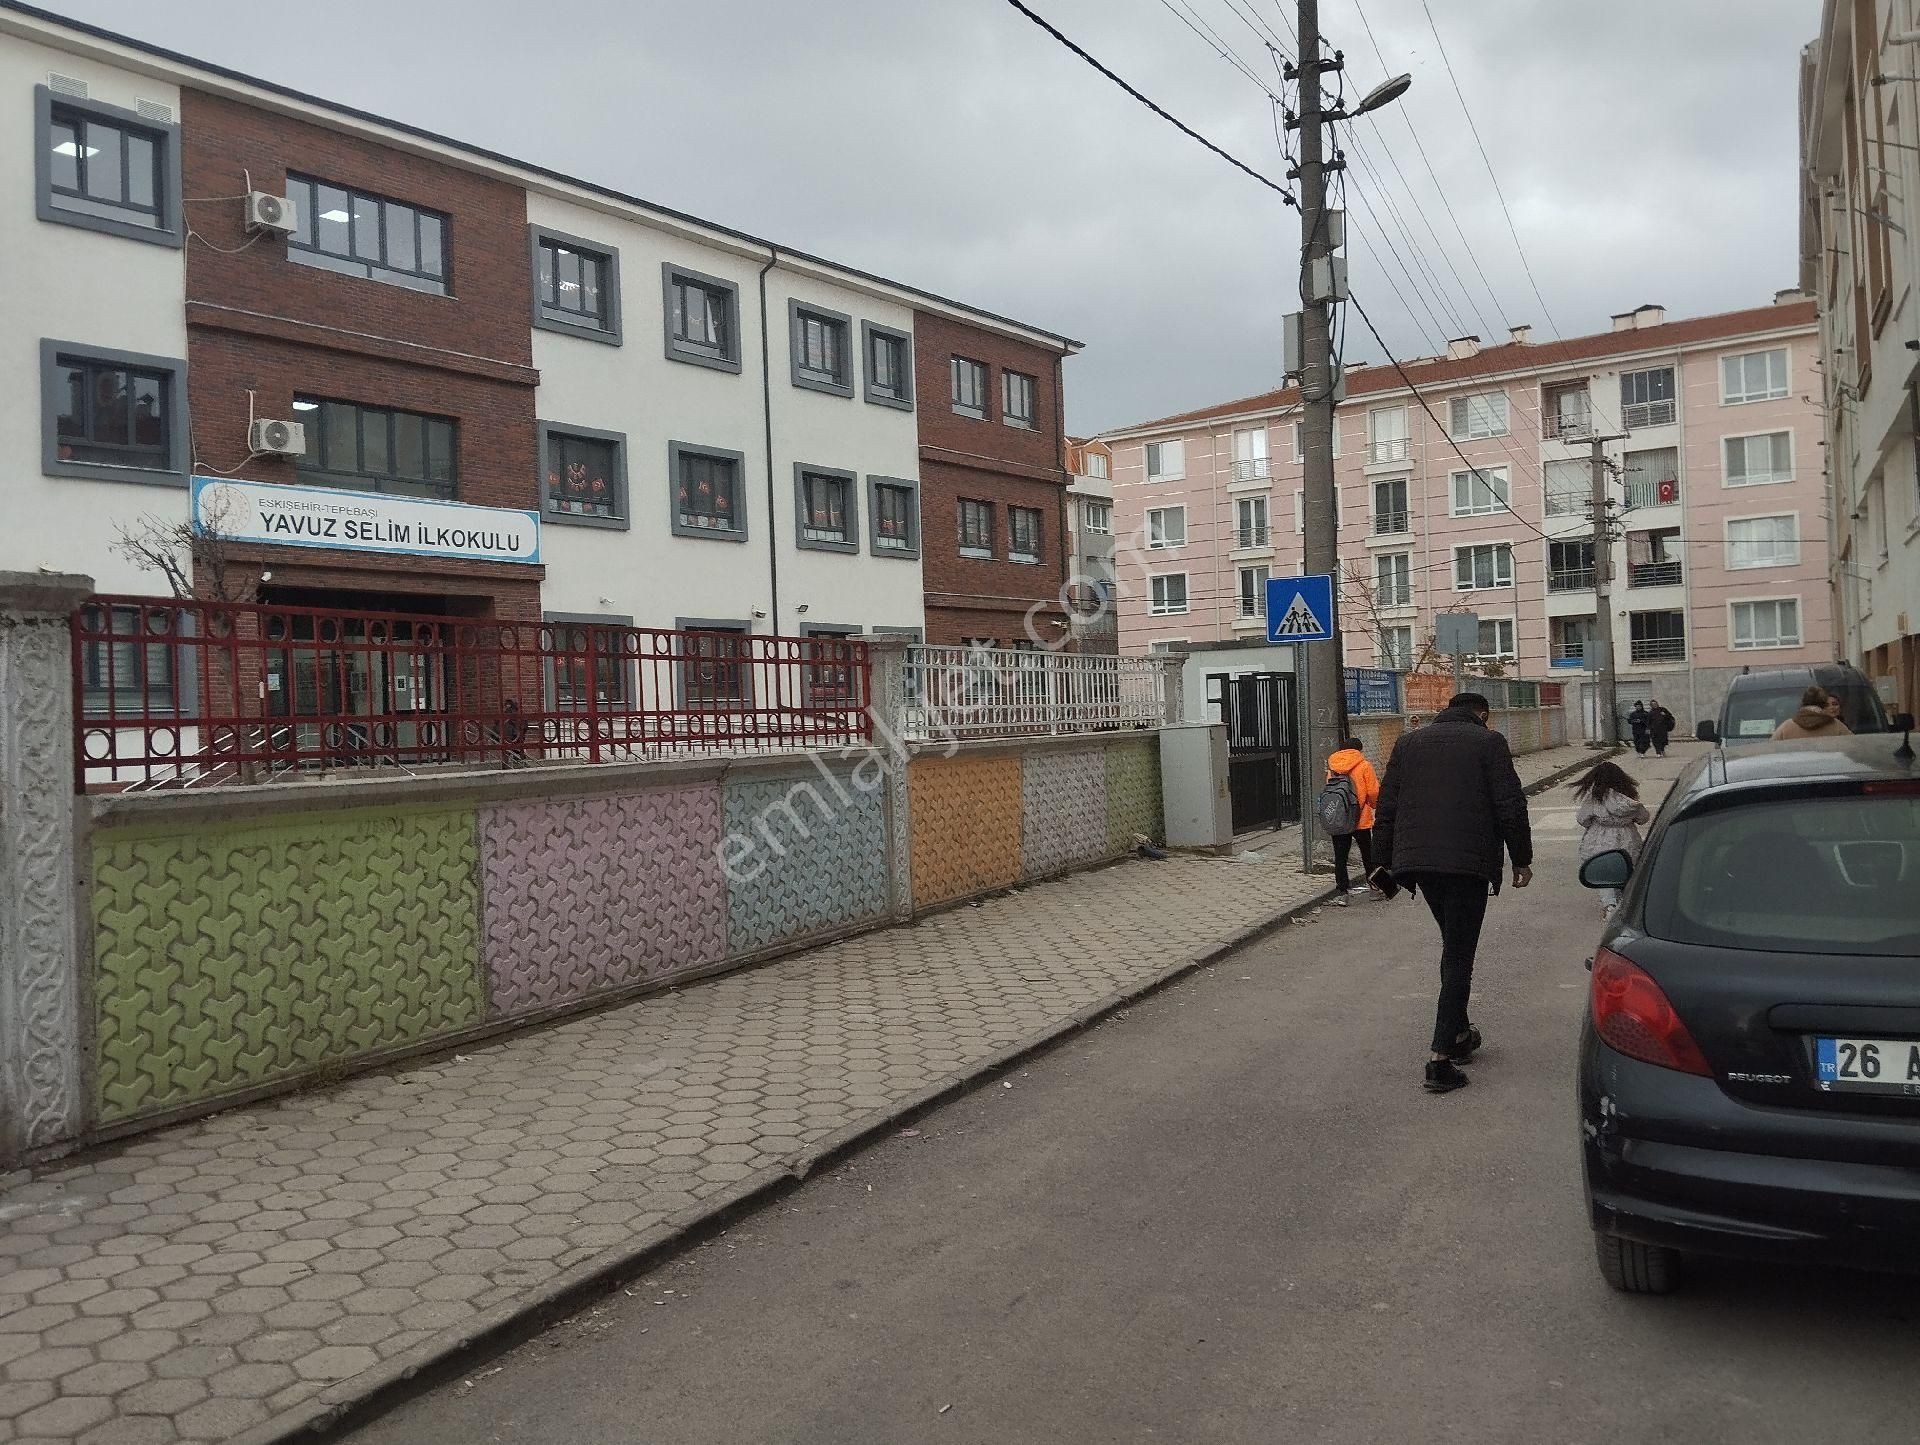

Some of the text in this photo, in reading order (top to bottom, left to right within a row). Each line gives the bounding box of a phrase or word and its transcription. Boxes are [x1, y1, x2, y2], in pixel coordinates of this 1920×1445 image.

[259, 511, 520, 552] YAVUZ SELİM İLKOKULU
[1727, 1072, 1792, 1084] PEUGEOT
[1820, 1062, 1835, 1073] TR
[1839, 1043, 1880, 1078] 26
